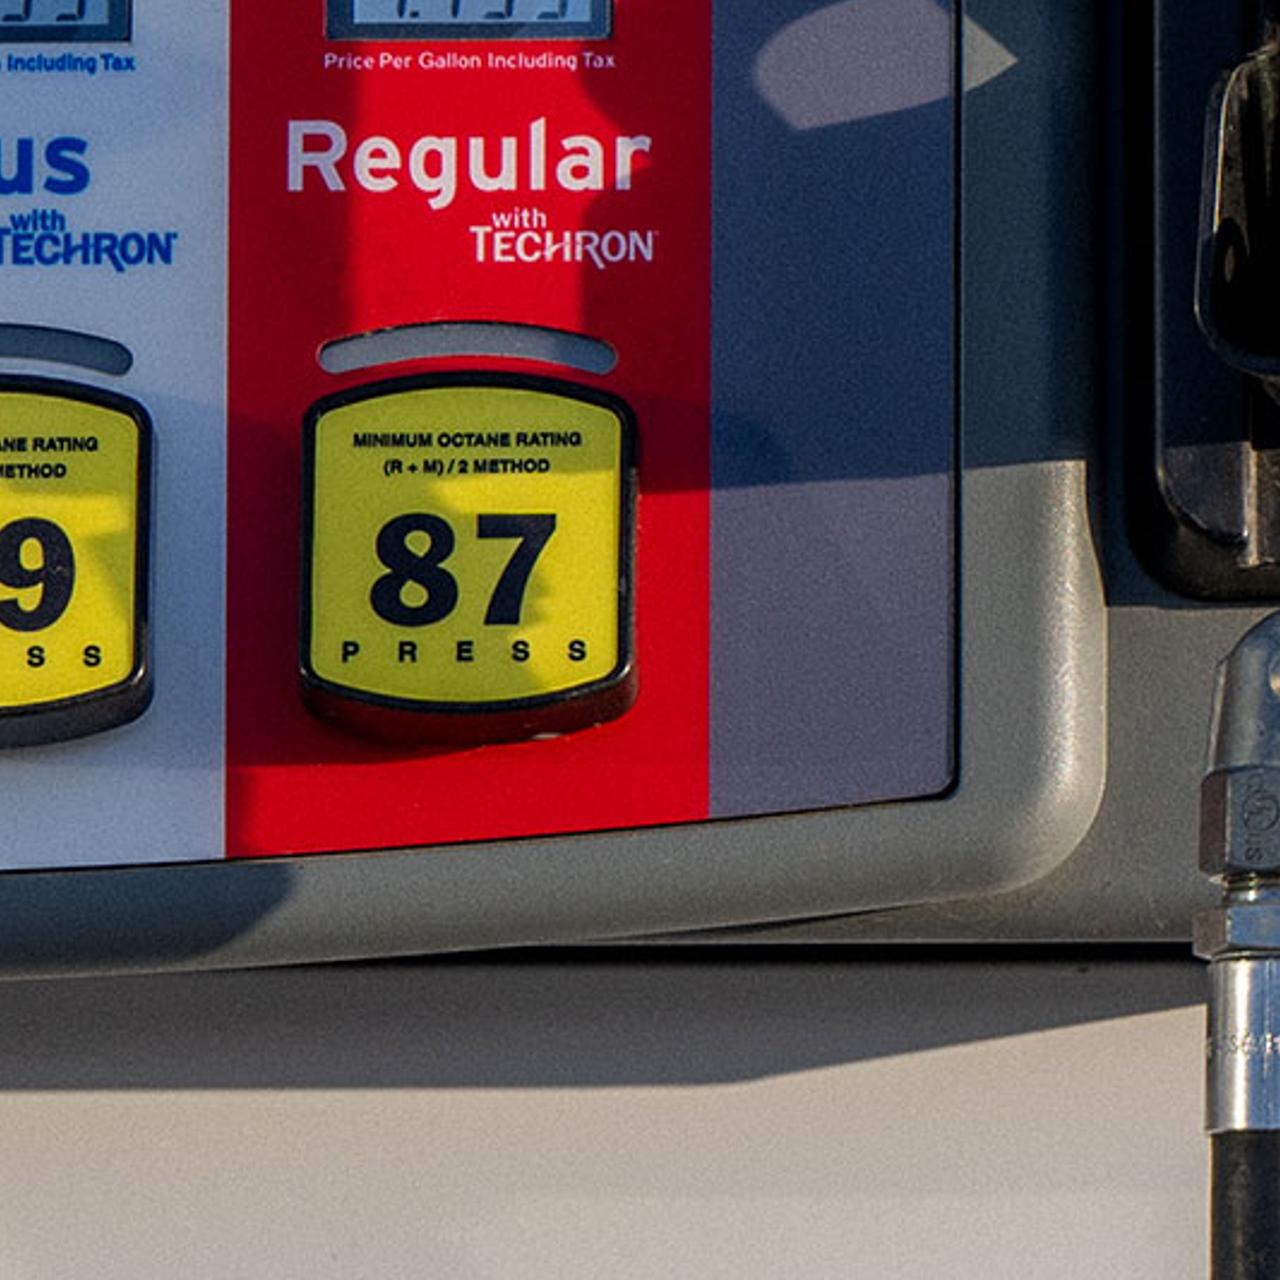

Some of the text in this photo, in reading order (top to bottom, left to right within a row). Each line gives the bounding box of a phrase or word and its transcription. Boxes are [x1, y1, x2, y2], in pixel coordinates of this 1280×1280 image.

[7, 53, 136, 74] Including Tax
[324, 51, 616, 71] Price Per Gallon Including Tax
[287, 117, 652, 210] Regular
[9, 209, 66, 231] with
[491, 207, 547, 228] with
[469, 225, 653, 269] TECHRON
[32, 437, 98, 452] RATING
[353, 432, 582, 447] MINIMUM OCTANE RATING
[384, 459, 550, 476] (R + M) / 2 METHOD
[370, 512, 557, 627] 87
